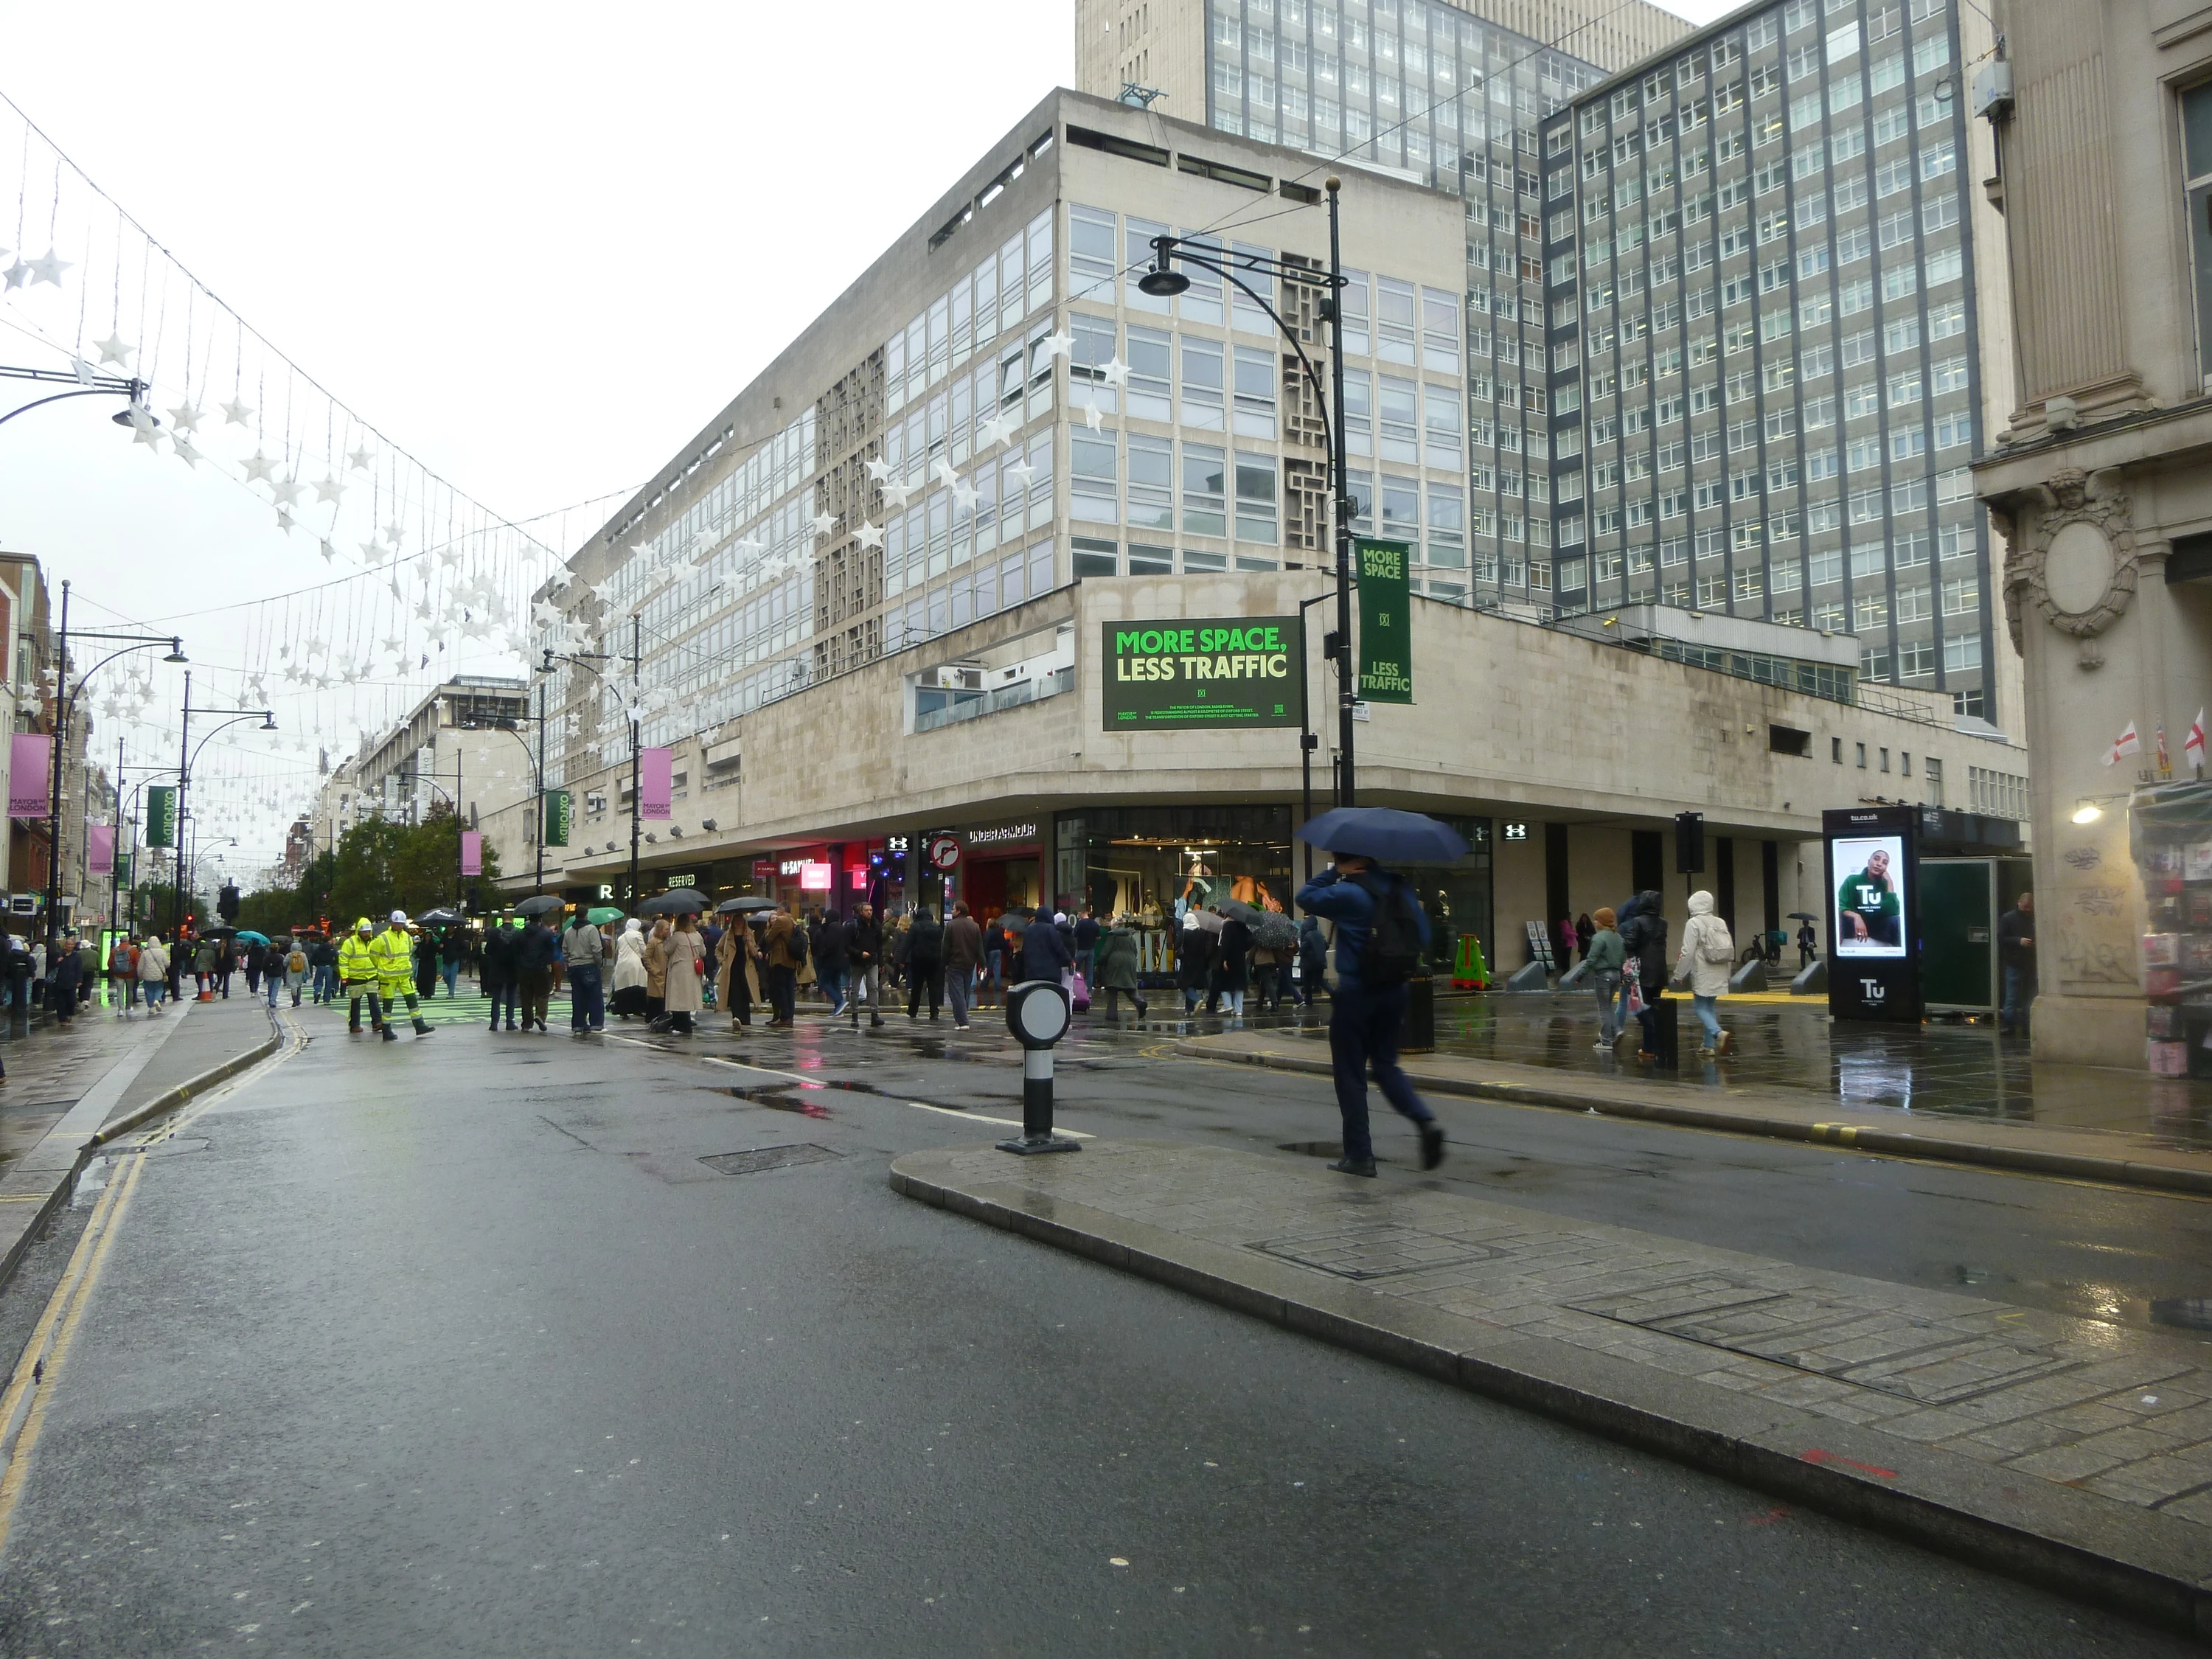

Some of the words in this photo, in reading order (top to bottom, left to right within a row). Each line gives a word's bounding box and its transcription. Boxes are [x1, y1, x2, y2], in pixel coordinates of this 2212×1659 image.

[1363, 549, 1401, 566] MORE
[1364, 562, 1401, 580] SPACE
[1116, 630, 1194, 654] MORE
[1200, 627, 1287, 653] SPACE,
[1117, 657, 1175, 681] LESS
[1180, 654, 1287, 680] TRAFFIC
[1372, 661, 1399, 676] LESS
[1360, 674, 1410, 692] TRAFFIC
[164, 790, 175, 836] OXFORD
[560, 794, 569, 835] OXFORD
[1851, 813, 1878, 821] tu.co.uk
[970, 829, 997, 843] UNDER
[998, 823, 1036, 840] ARMOUR
[668, 874, 695, 888] RESERVED
[1856, 885, 1882, 905] Tu
[1860, 979, 1885, 998] Tu
